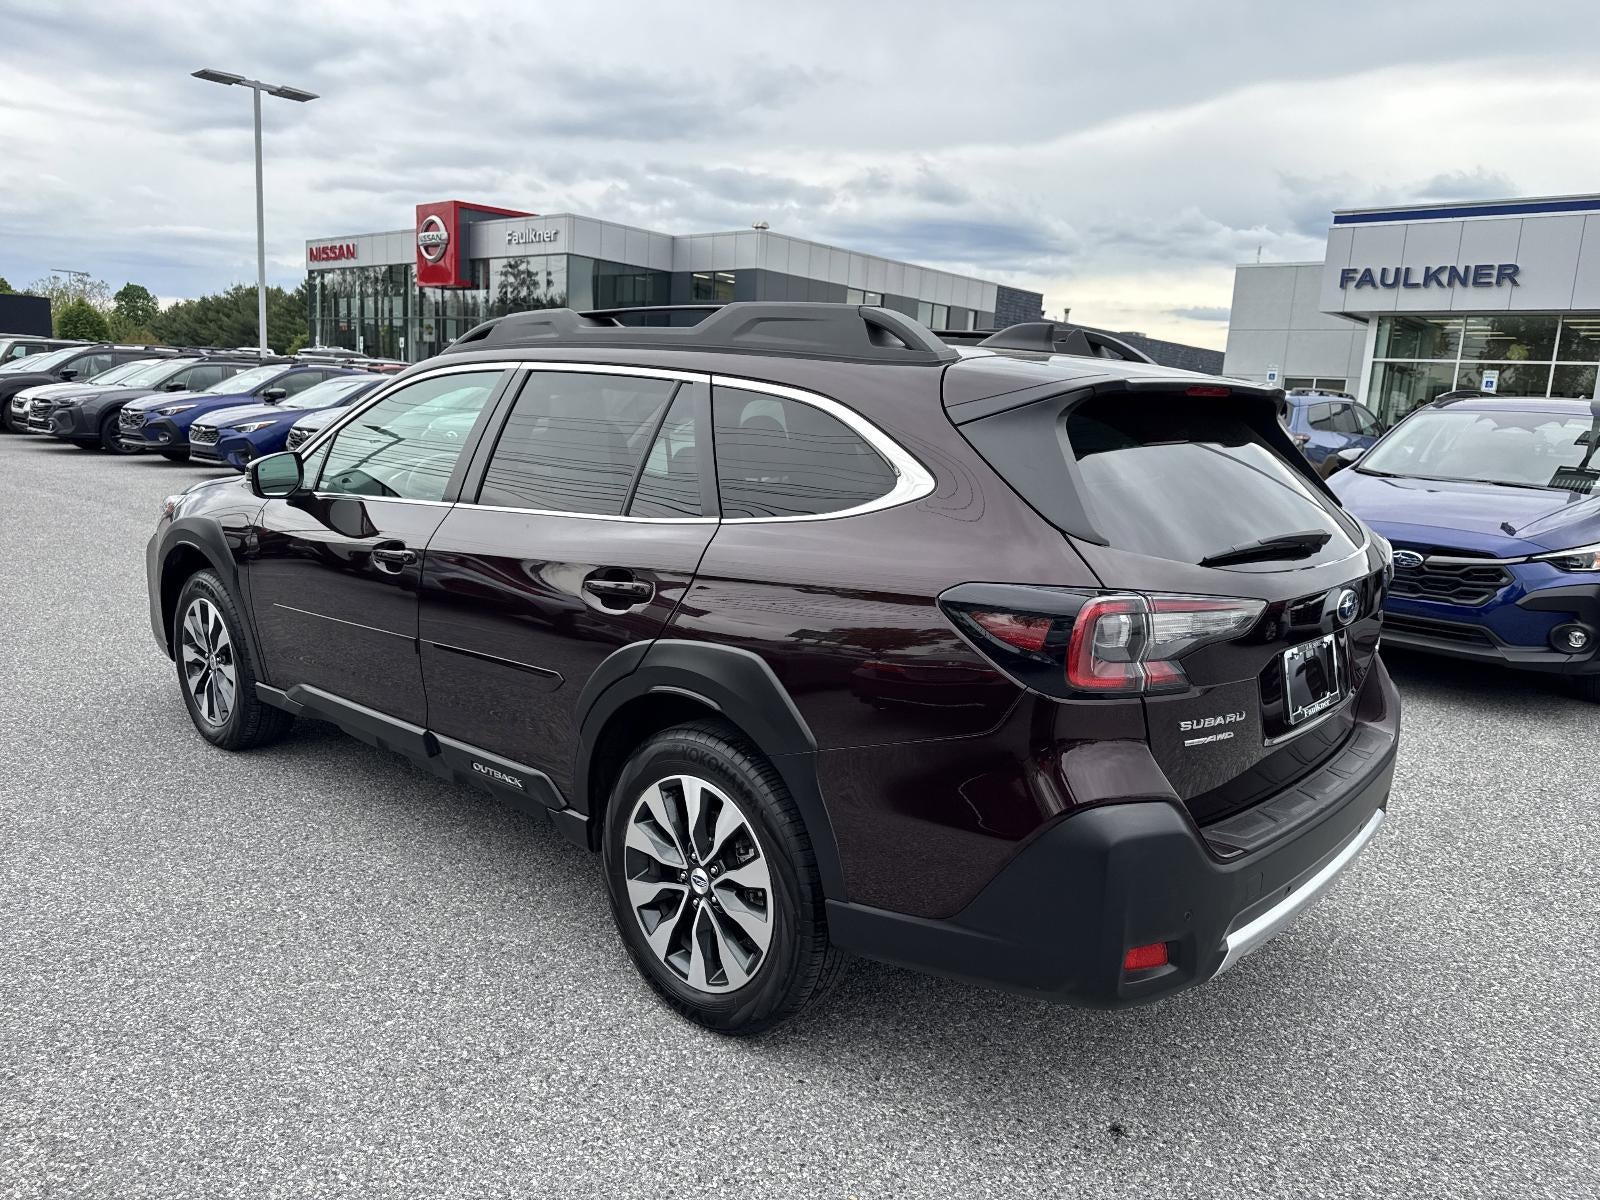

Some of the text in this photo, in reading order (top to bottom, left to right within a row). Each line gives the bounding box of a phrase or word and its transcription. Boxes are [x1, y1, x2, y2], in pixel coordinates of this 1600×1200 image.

[418, 233, 442, 243] NISSAN
[506, 228, 558, 245] Faulkner
[309, 243, 356, 262] NISSAN
[1339, 264, 1520, 290] FAULKNER
[1303, 698, 1331, 718] Faulkner
[1180, 711, 1246, 731] SUBARU
[1204, 732, 1235, 744] AWD
[472, 762, 523, 788] OUTBACK
